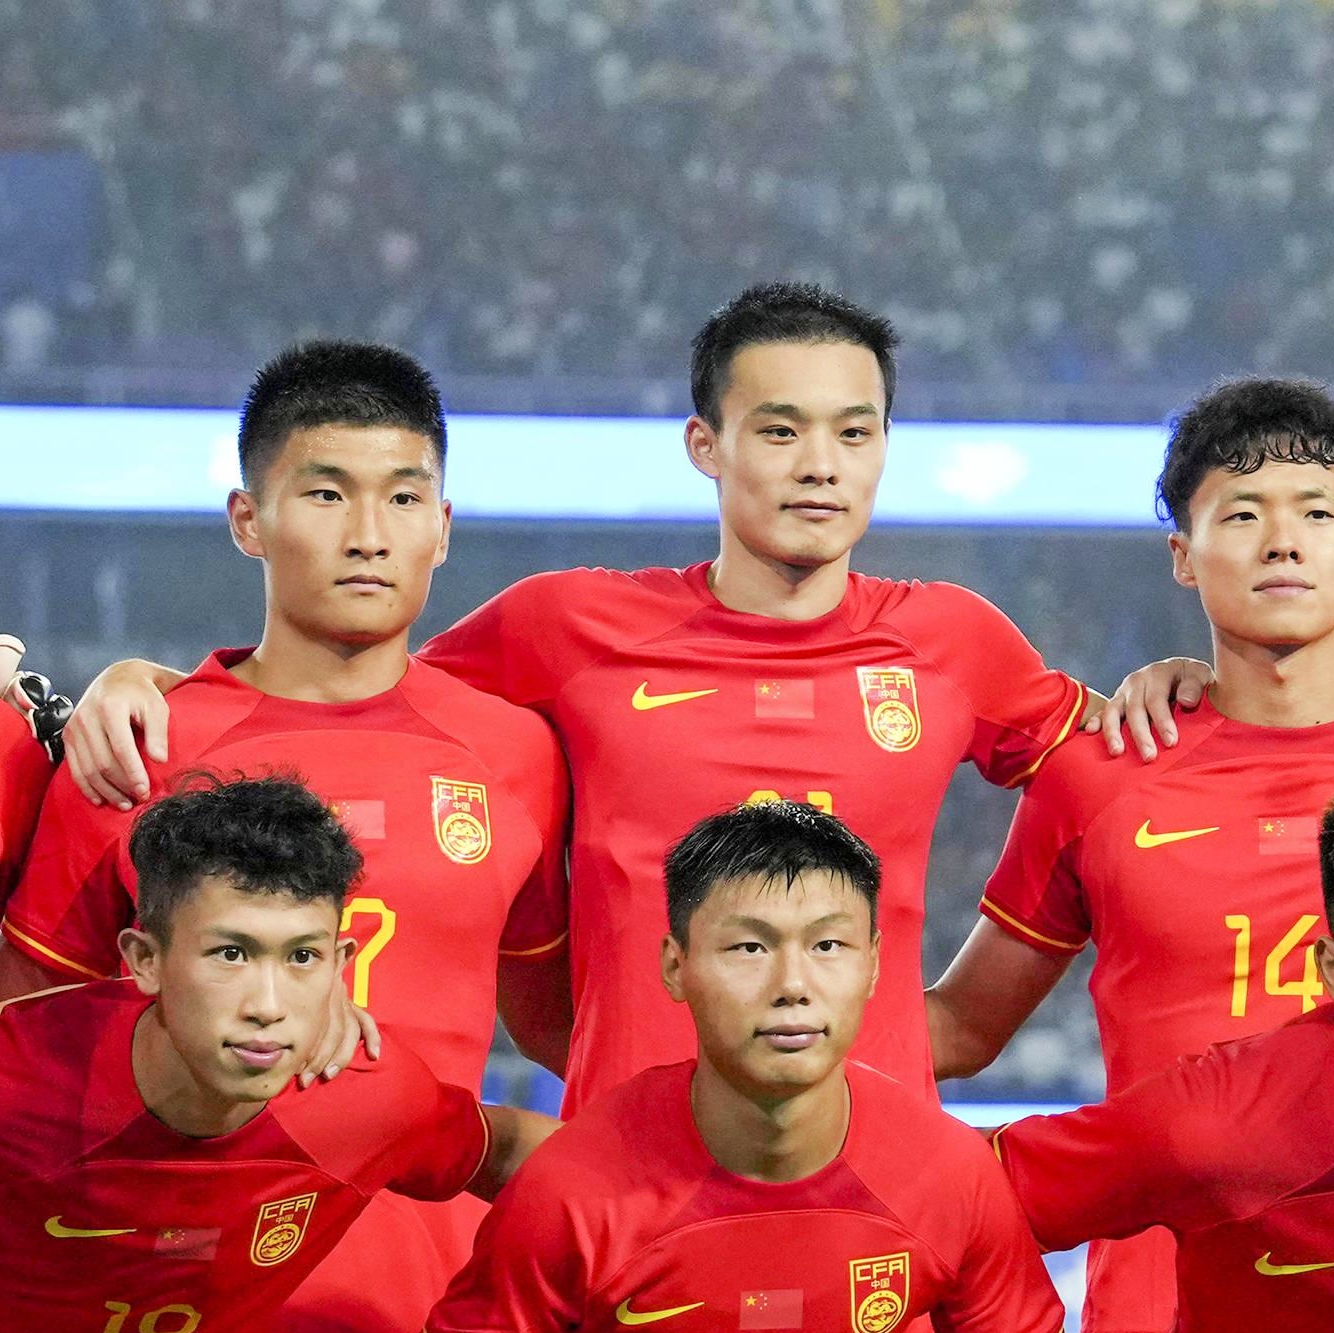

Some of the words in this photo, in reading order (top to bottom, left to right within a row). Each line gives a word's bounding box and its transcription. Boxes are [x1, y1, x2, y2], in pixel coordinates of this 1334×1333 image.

[865, 675, 910, 689] CFA
[437, 784, 483, 804] CFA
[1224, 914, 1324, 1017] 14
[263, 1198, 311, 1219] CFA
[856, 1259, 904, 1281] CFA
